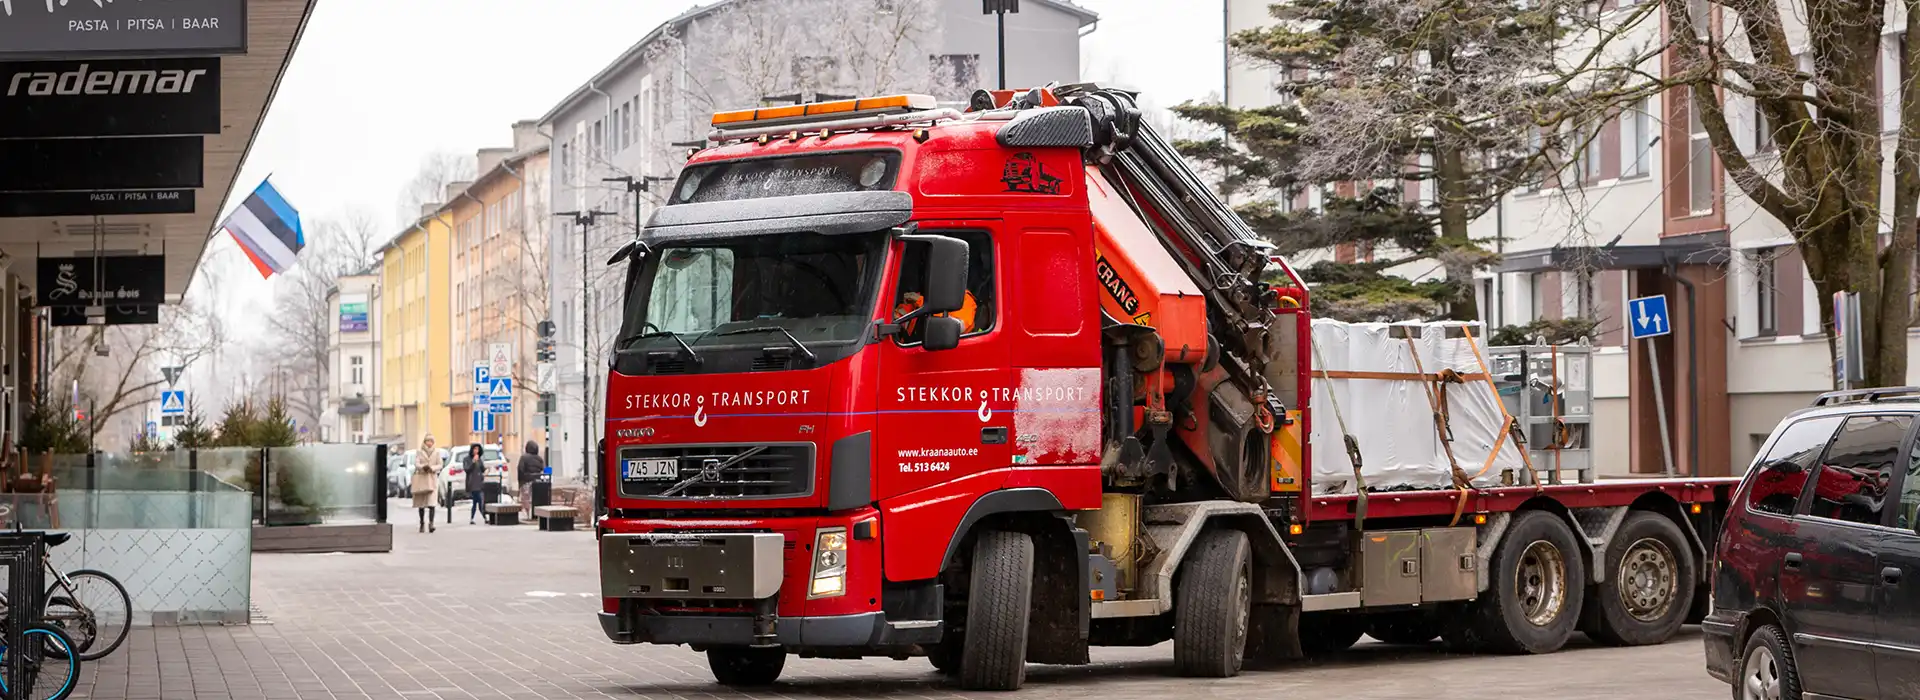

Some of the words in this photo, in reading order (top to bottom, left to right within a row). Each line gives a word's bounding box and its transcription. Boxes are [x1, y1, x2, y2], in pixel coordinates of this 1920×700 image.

[68, 19, 109, 31] PASTA
[127, 18, 164, 30] PITSA
[182, 17, 219, 29] BAAR
[6, 63, 206, 97] rademar
[773, 166, 839, 179] TRANSPORT
[90, 193, 115, 201] PASTA
[124, 192, 147, 200] PITSA
[157, 191, 180, 200] BAAR
[1097, 261, 1137, 311] CRANE
[625, 393, 691, 409] STEKKOR
[711, 390, 810, 406] TRANSPORT
[897, 387, 973, 401] STEKKOR
[992, 387, 1084, 401] TRANSPORT
[616, 427, 655, 437] VOLVO
[897, 447, 979, 457] www.kraanaauto.ee
[630, 462, 648, 475] 745
[654, 461, 675, 475] JZN
[898, 462, 913, 472] Tel.
[914, 462, 929, 472] 513
[930, 461, 950, 472] 6424
